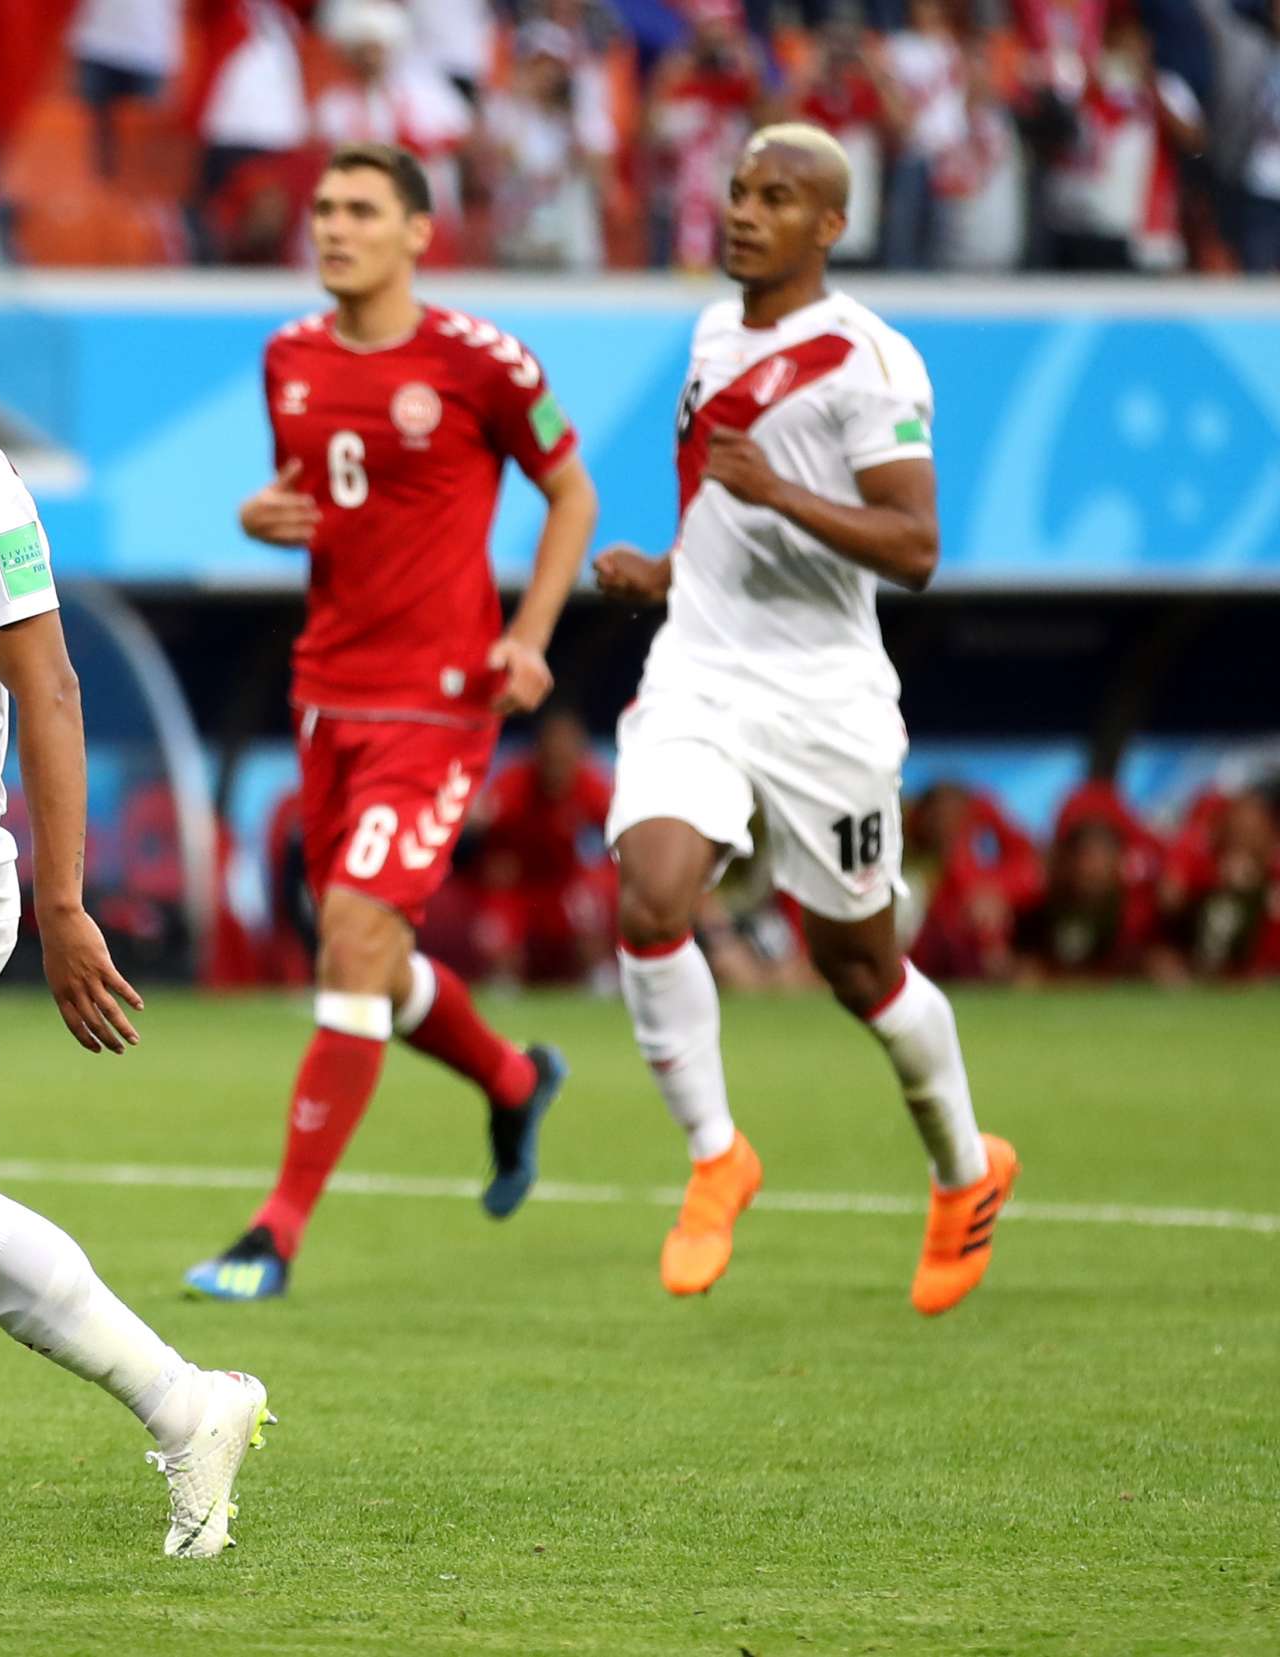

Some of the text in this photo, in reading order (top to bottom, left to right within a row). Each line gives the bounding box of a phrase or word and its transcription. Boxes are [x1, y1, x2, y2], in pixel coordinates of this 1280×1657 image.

[328, 430, 369, 508] 6
[345, 804, 399, 879] 6
[832, 811, 882, 872] 18
